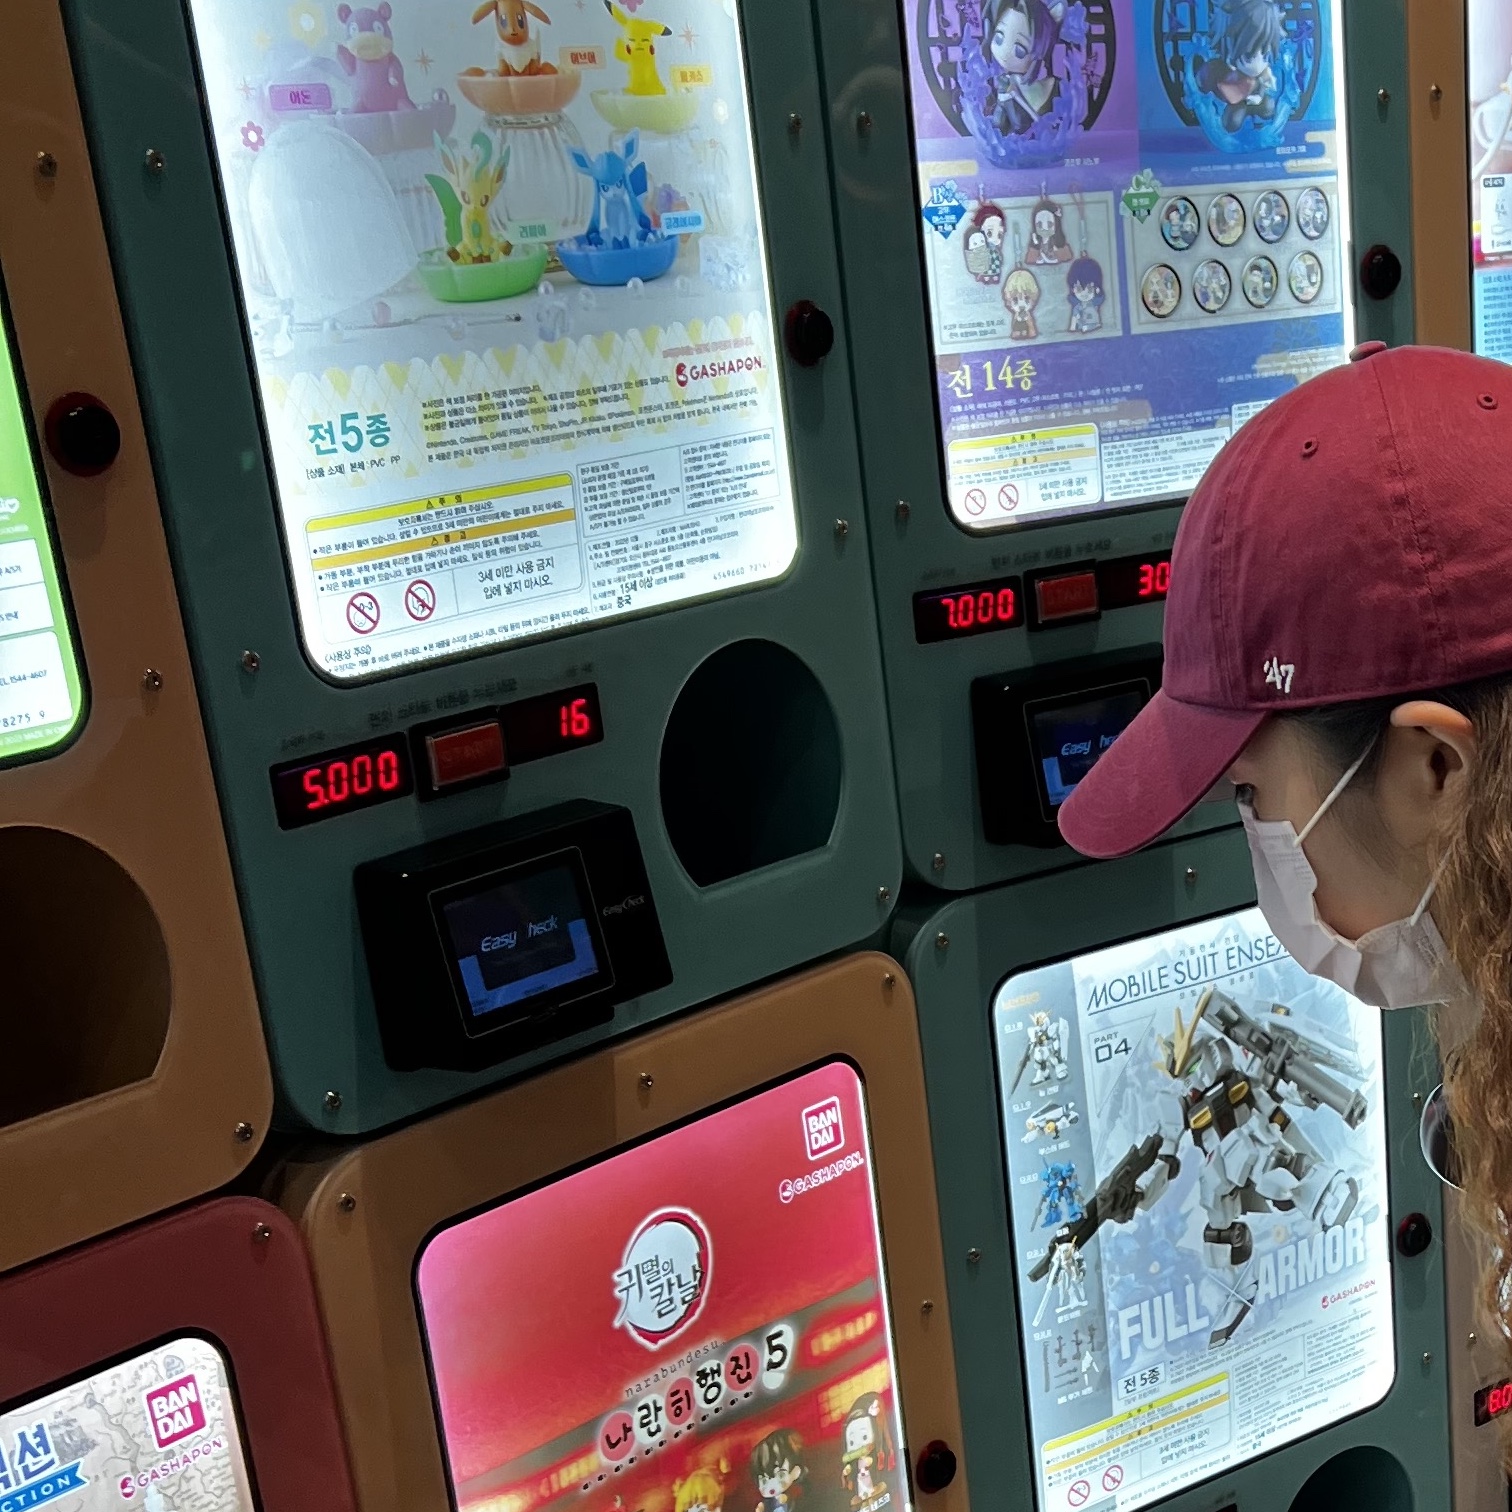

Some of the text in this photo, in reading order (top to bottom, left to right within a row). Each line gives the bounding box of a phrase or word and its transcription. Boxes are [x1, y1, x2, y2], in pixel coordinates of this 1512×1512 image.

[689, 356, 763, 381] GASHAPON
[948, 356, 1037, 399] 전 14종
[1138, 561, 1171, 596] 30
[560, 698, 590, 737] 16
[1061, 740, 1092, 756] Easy
[481, 930, 518, 952] Easy
[1087, 965, 1170, 1010] MOBILE
[1174, 951, 1219, 985] SUIT
[1093, 1030, 1119, 1045] PART
[1094, 1038, 1132, 1064] 04
[807, 1106, 838, 1134] BAN
[810, 1125, 835, 1151] DAI
[615, 1254, 676, 1323] 귀멸의
[650, 1250, 705, 1320] 칼날
[1117, 1222, 1367, 1360] FULL ARMOR
[765, 1329, 788, 1372] 5
[1124, 1366, 1161, 1394] 전 5종
[151, 1381, 198, 1419] BAN
[156, 1406, 195, 1440] DAI
[0, 1423, 56, 1491] 션
[137, 1438, 223, 1487] GASHAPON
